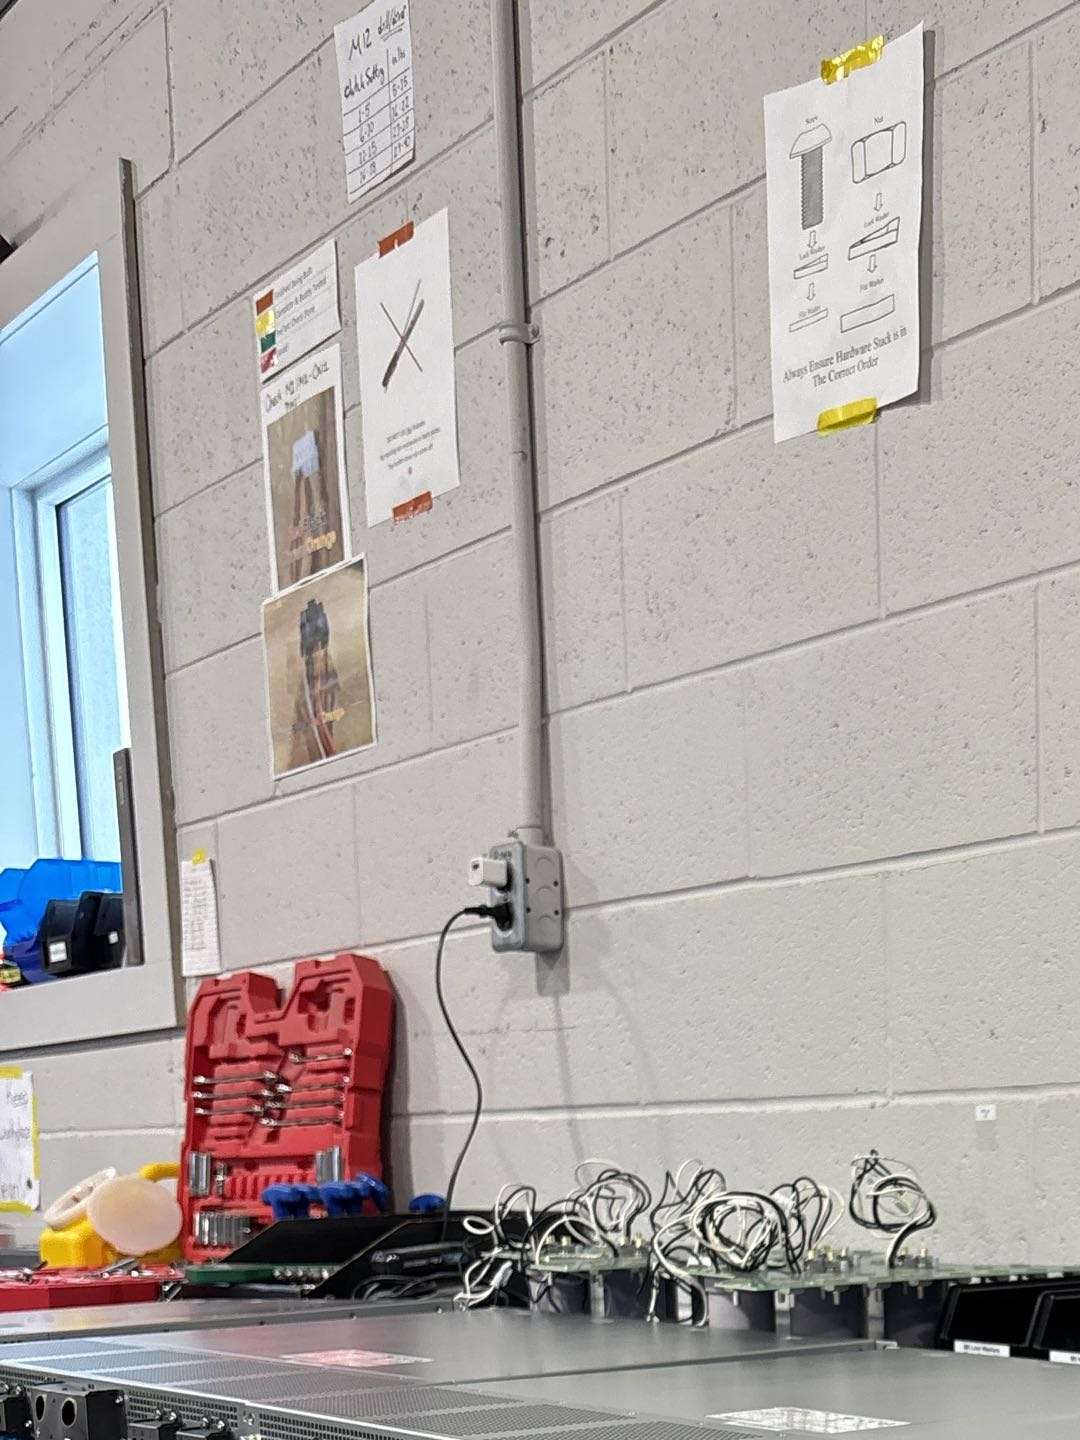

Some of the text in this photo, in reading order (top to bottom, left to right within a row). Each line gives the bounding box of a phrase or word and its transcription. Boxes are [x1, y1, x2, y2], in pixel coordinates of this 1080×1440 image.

[783, 366, 808, 383] Always
[809, 356, 835, 373] Ensure
[835, 343, 872, 363] Hardware
[873, 331, 891, 350] Stack
[893, 331, 900, 341] is
[812, 356, 879, 387] The Correct Order
